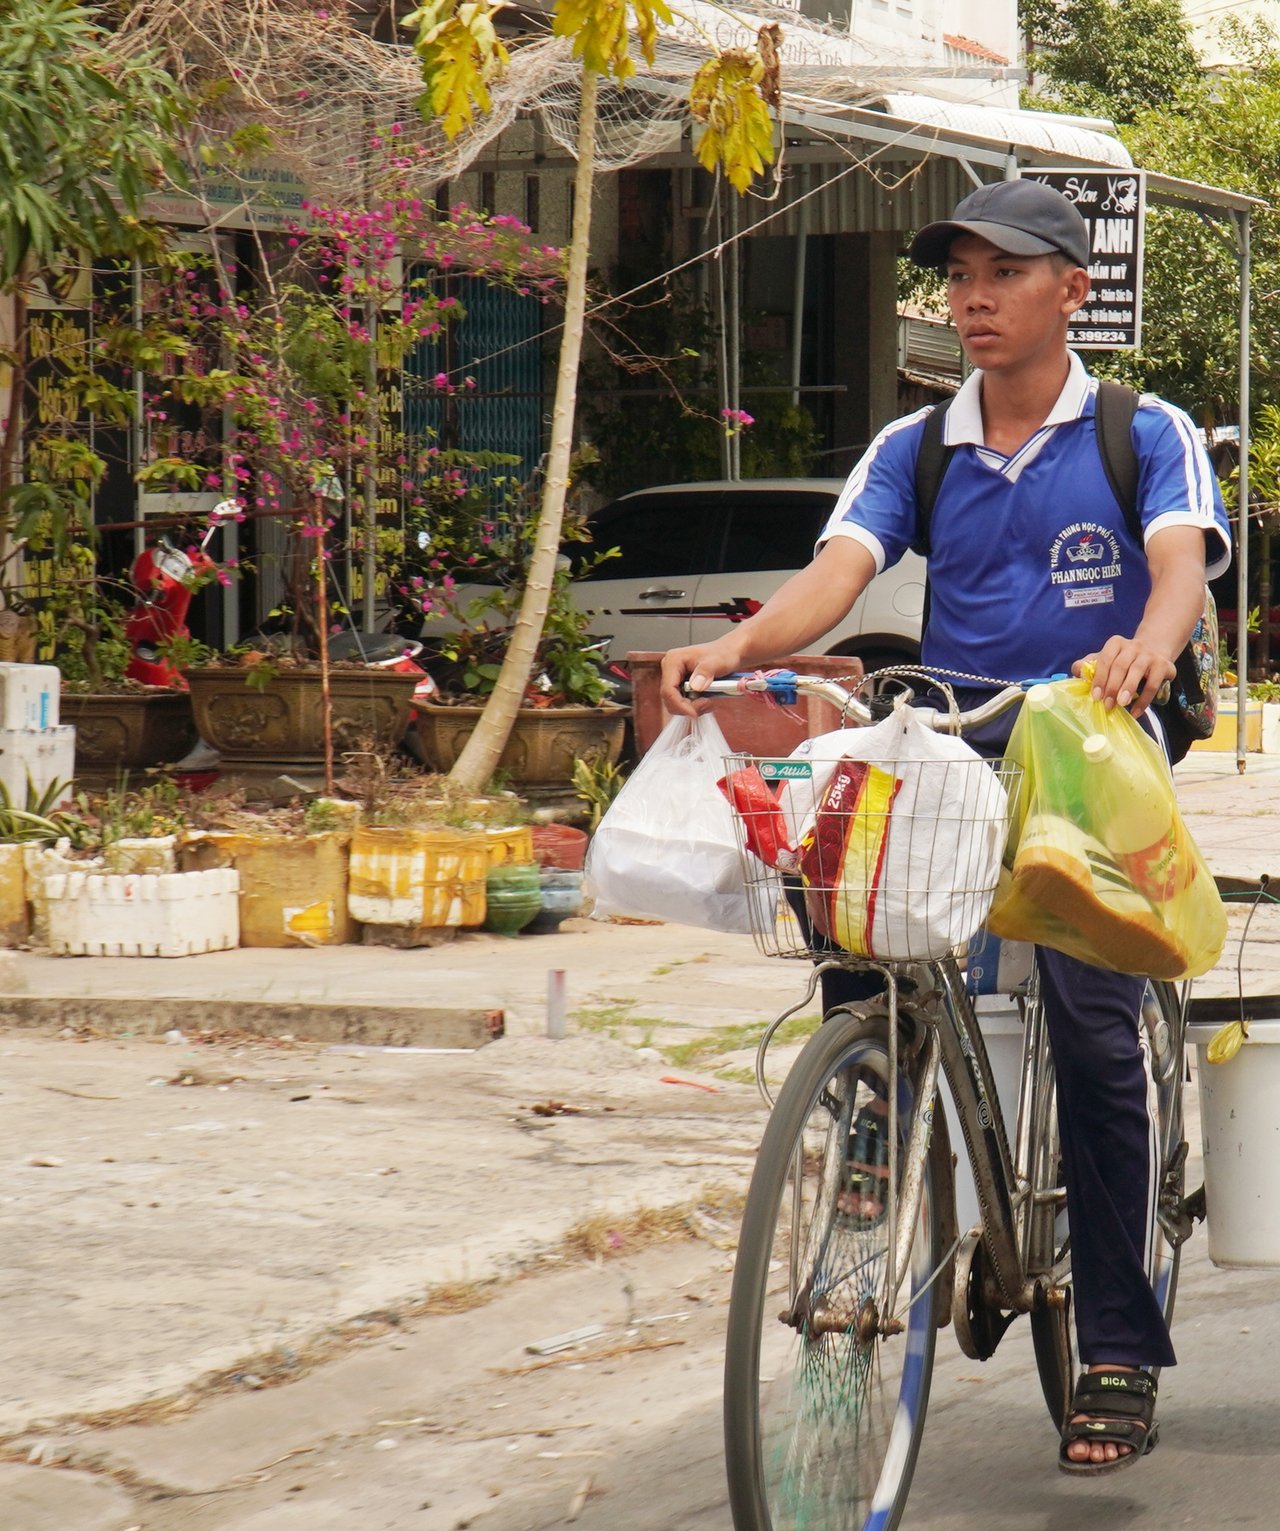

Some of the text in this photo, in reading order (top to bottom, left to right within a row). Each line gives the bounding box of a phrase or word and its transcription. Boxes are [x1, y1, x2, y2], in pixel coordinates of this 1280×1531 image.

[1092, 218, 1134, 254] ANH
[1088, 260, 1109, 280] HẨM
[1059, 523, 1081, 541] TRUNG
[1081, 522, 1097, 533] HỌC
[1051, 570, 1076, 585] PHAN
[1076, 567, 1101, 584] NGỌC
[1101, 1376, 1128, 1387] BICA
